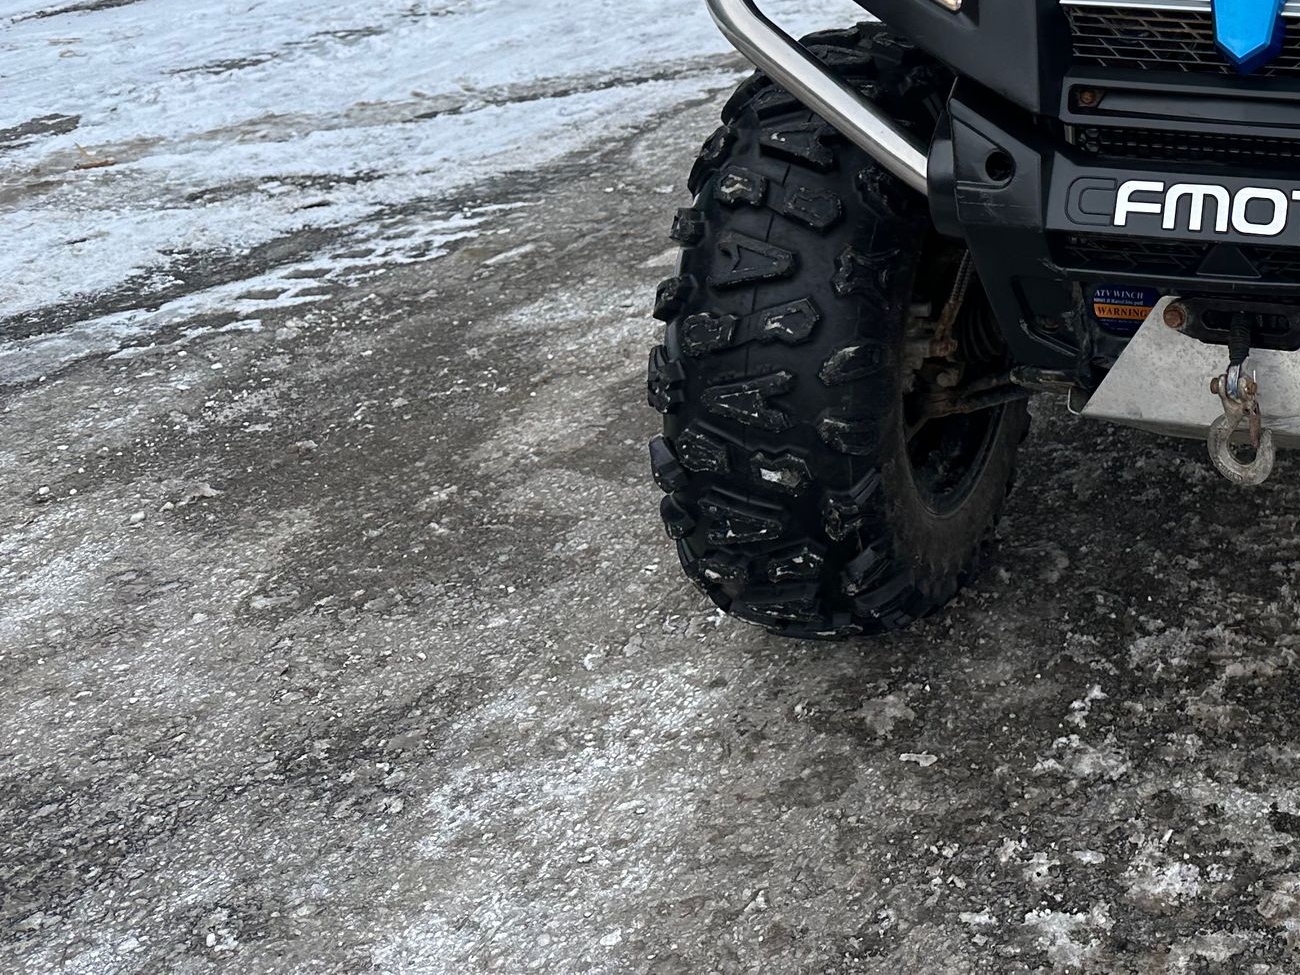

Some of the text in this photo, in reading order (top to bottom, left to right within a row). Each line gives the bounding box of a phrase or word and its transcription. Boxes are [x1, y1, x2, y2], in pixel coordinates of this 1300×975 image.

[1094, 289, 1144, 299] ATV WINCH
[1097, 306, 1148, 317] WARNING
